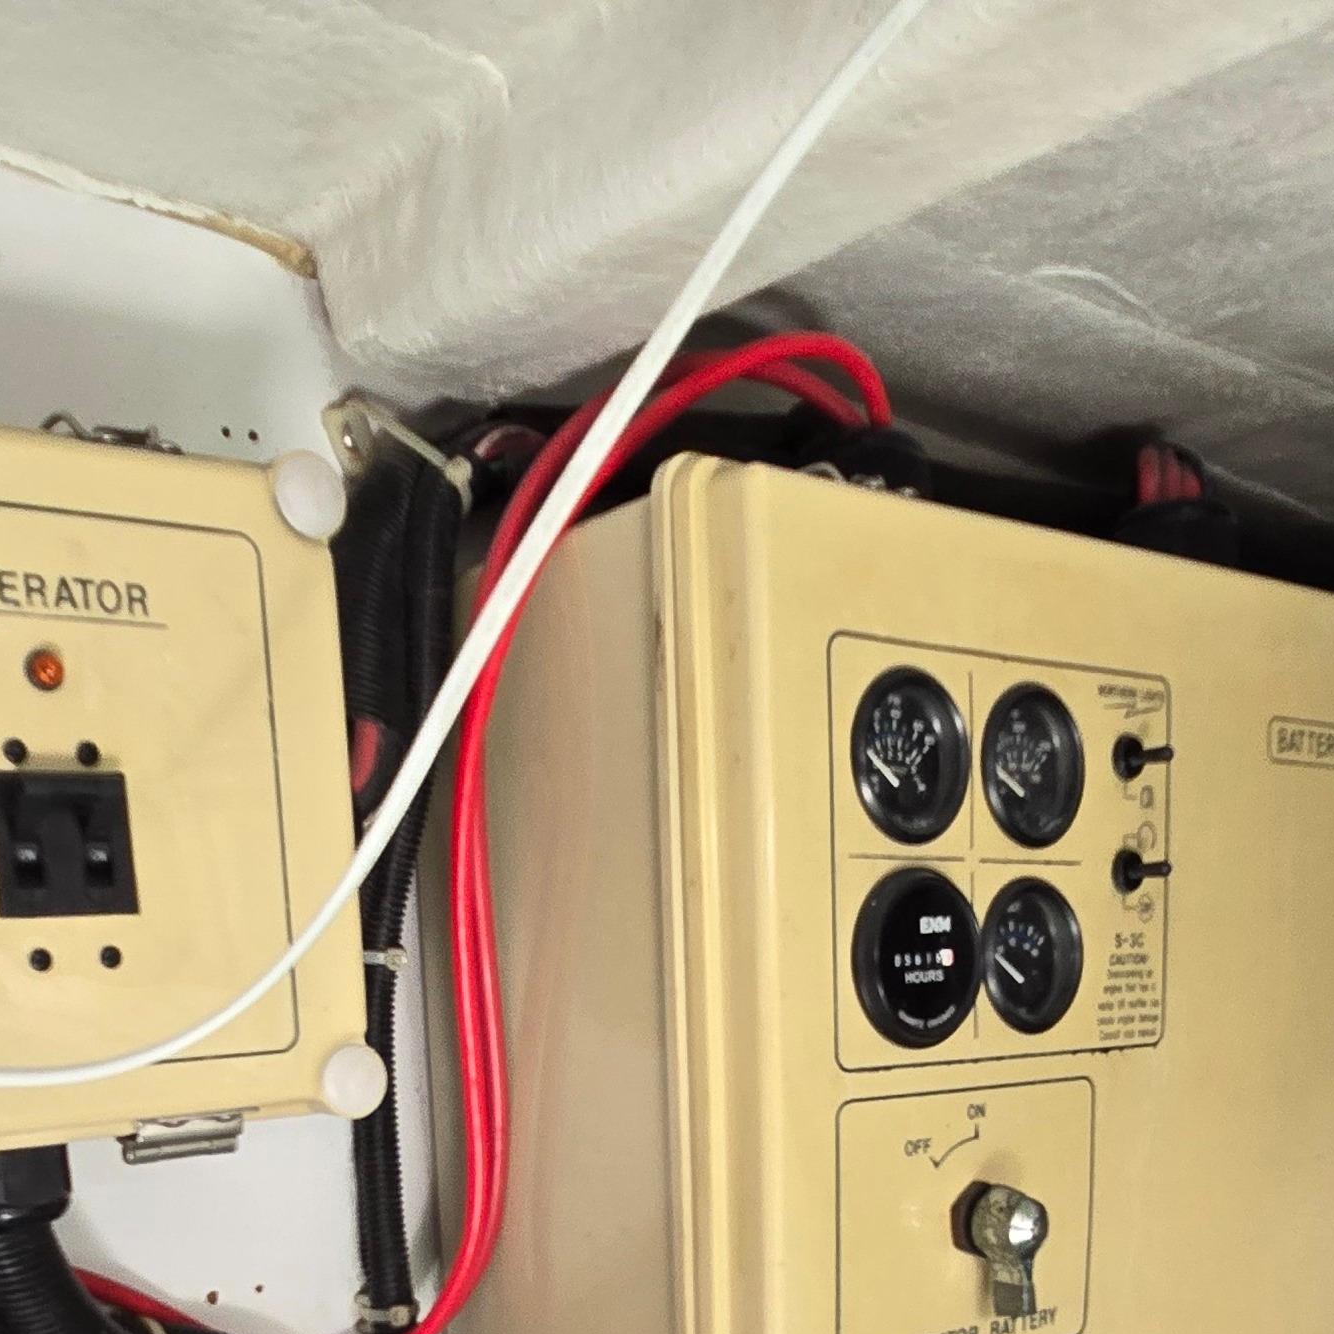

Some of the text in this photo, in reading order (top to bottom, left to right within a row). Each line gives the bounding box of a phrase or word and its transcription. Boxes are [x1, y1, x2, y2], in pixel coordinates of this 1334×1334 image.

[904, 969, 944, 984] HOURS
[967, 1103, 986, 1120] ON
[904, 1138, 932, 1157] OFF
